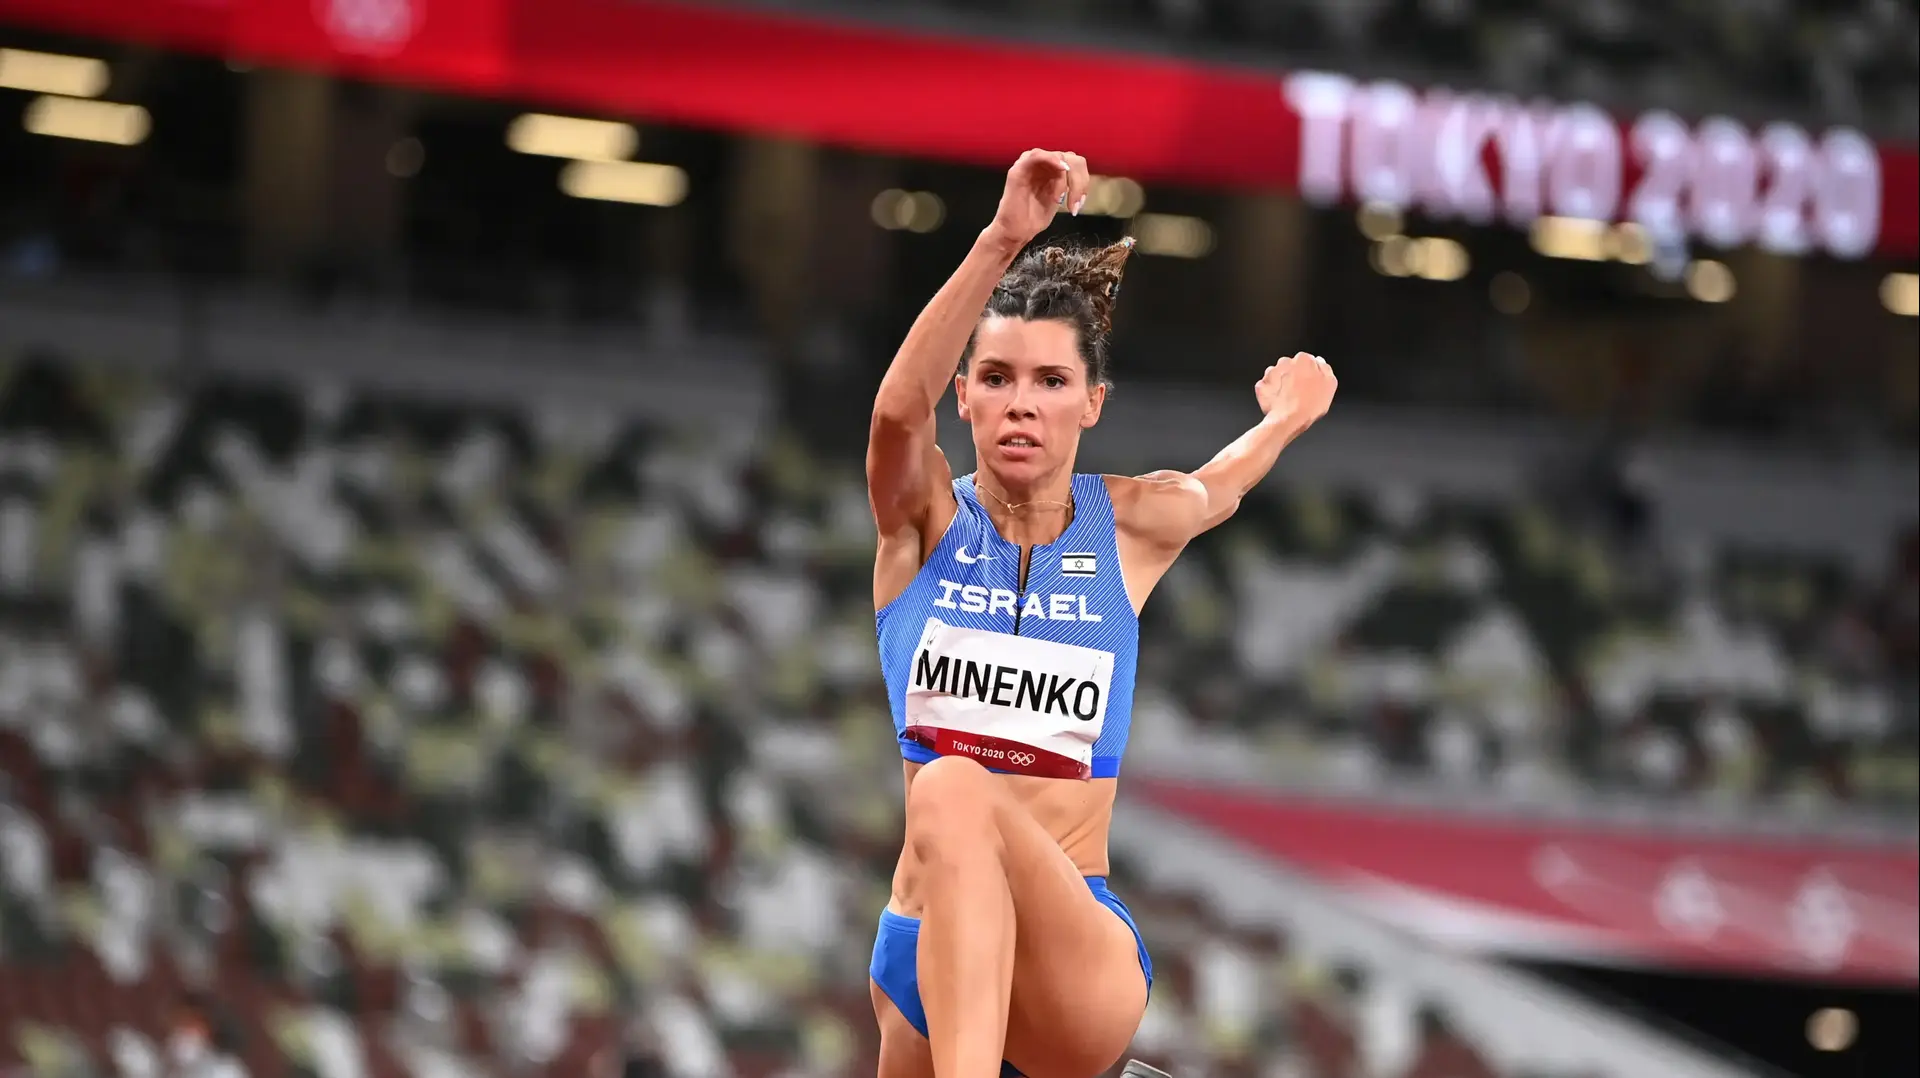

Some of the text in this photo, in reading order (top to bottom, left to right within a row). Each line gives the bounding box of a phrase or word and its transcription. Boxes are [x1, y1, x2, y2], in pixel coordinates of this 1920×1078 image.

[1282, 70, 1882, 259] TOKYO 2020
[933, 579, 1102, 622] ISRAEL
[915, 648, 1100, 722] MINENKO
[952, 740, 1004, 759] TOKYO 2020
